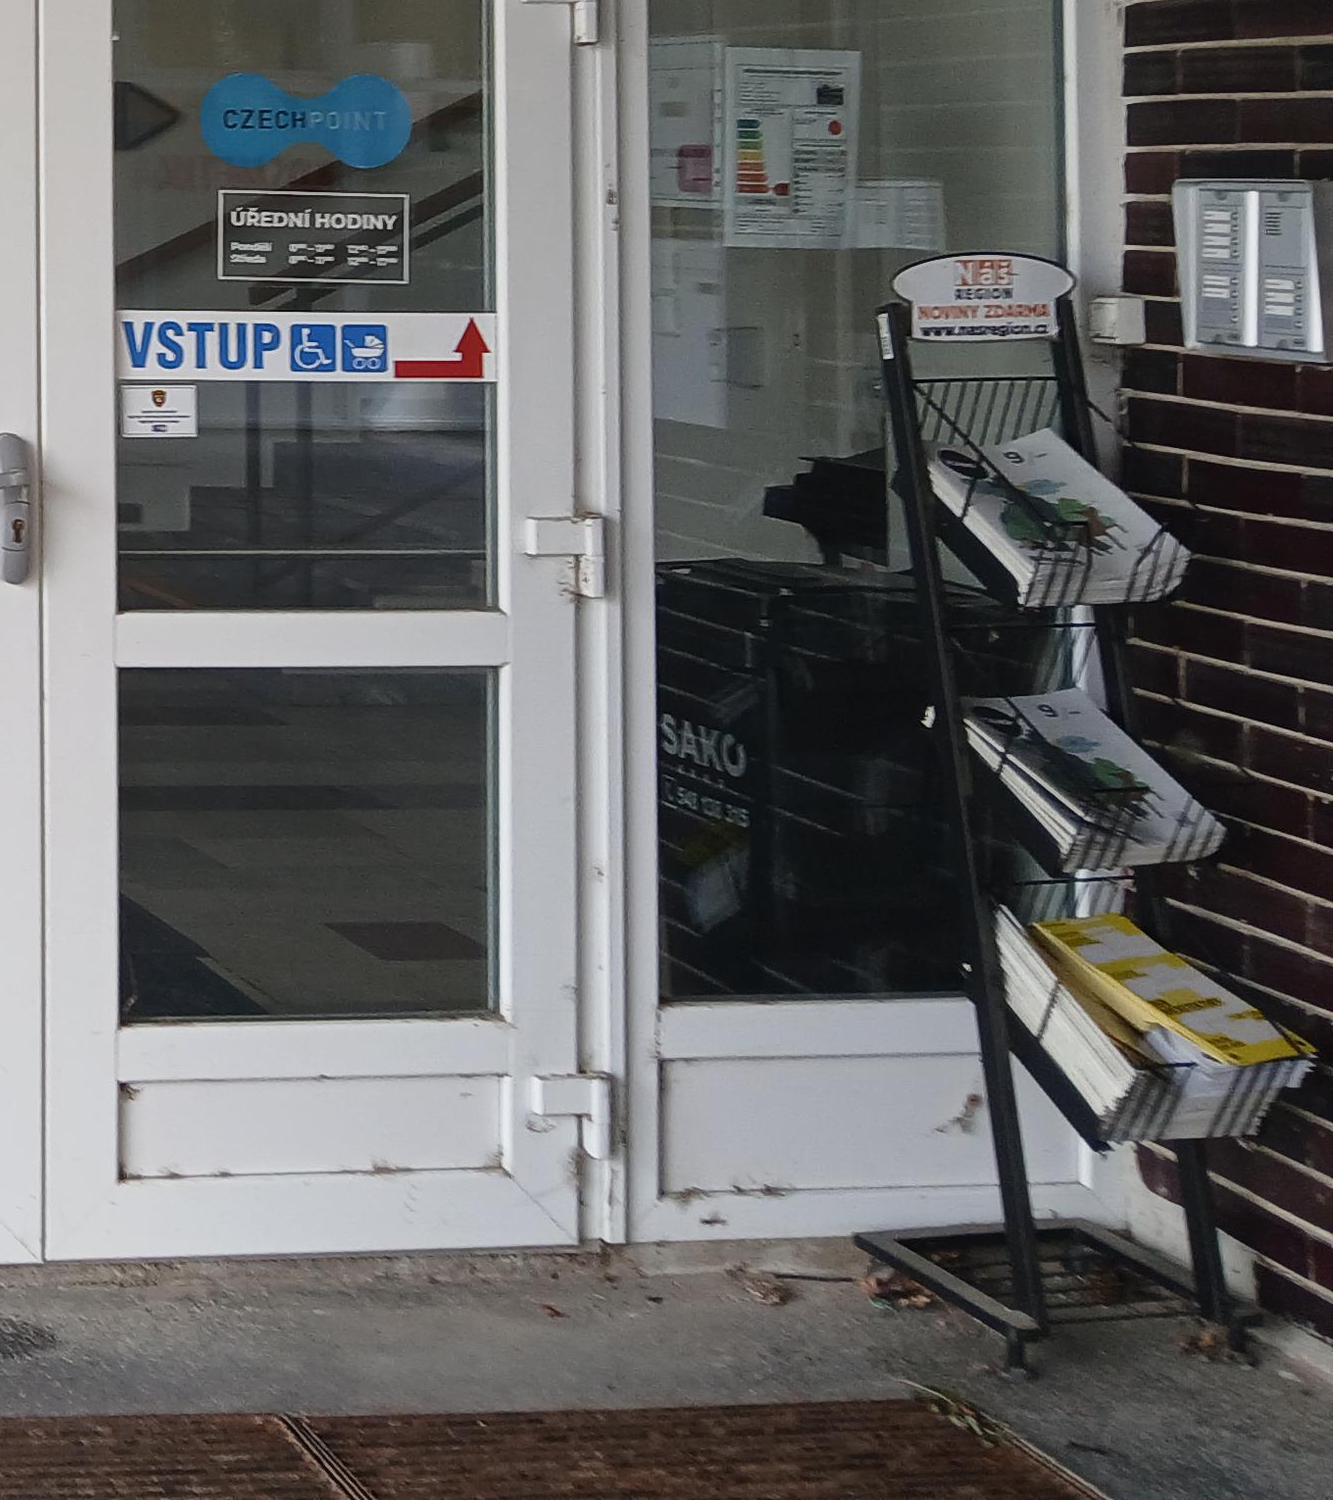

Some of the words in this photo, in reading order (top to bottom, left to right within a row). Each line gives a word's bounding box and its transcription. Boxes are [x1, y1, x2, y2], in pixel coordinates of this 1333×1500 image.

[229, 207, 312, 228] ÚŘEDNÍ
[314, 213, 398, 231] HODINY
[122, 320, 281, 370] VSTUP
[660, 713, 747, 778] SAKO
